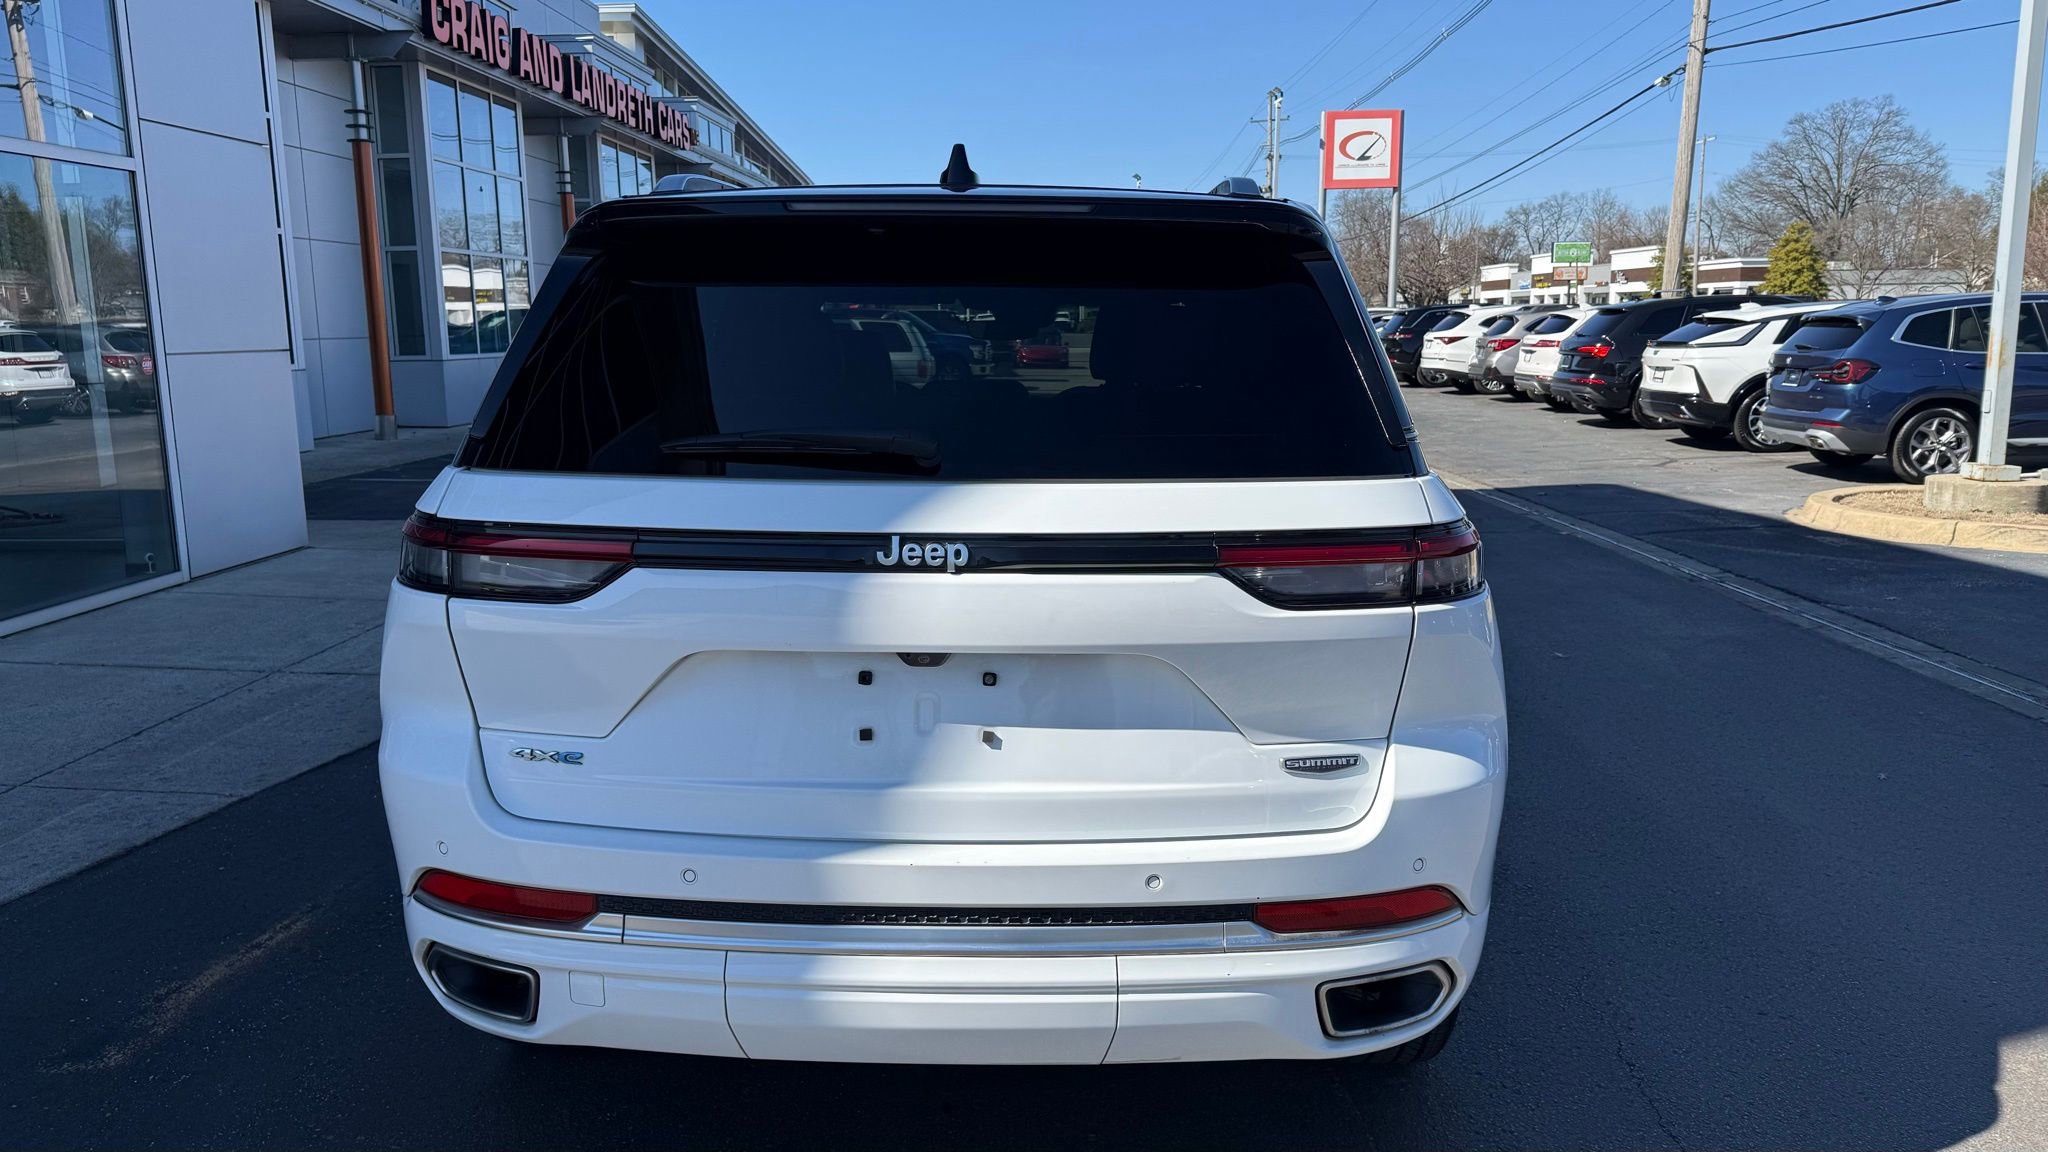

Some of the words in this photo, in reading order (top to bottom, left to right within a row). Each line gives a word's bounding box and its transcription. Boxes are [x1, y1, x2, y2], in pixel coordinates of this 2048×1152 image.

[431, 0, 510, 70] CRAIG
[519, 29, 565, 94] AND
[569, 54, 655, 136] LANDRETH
[657, 101, 691, 149] CARS
[876, 535, 969, 573] Jeep
[1286, 757, 1357, 767] SUMMIT
